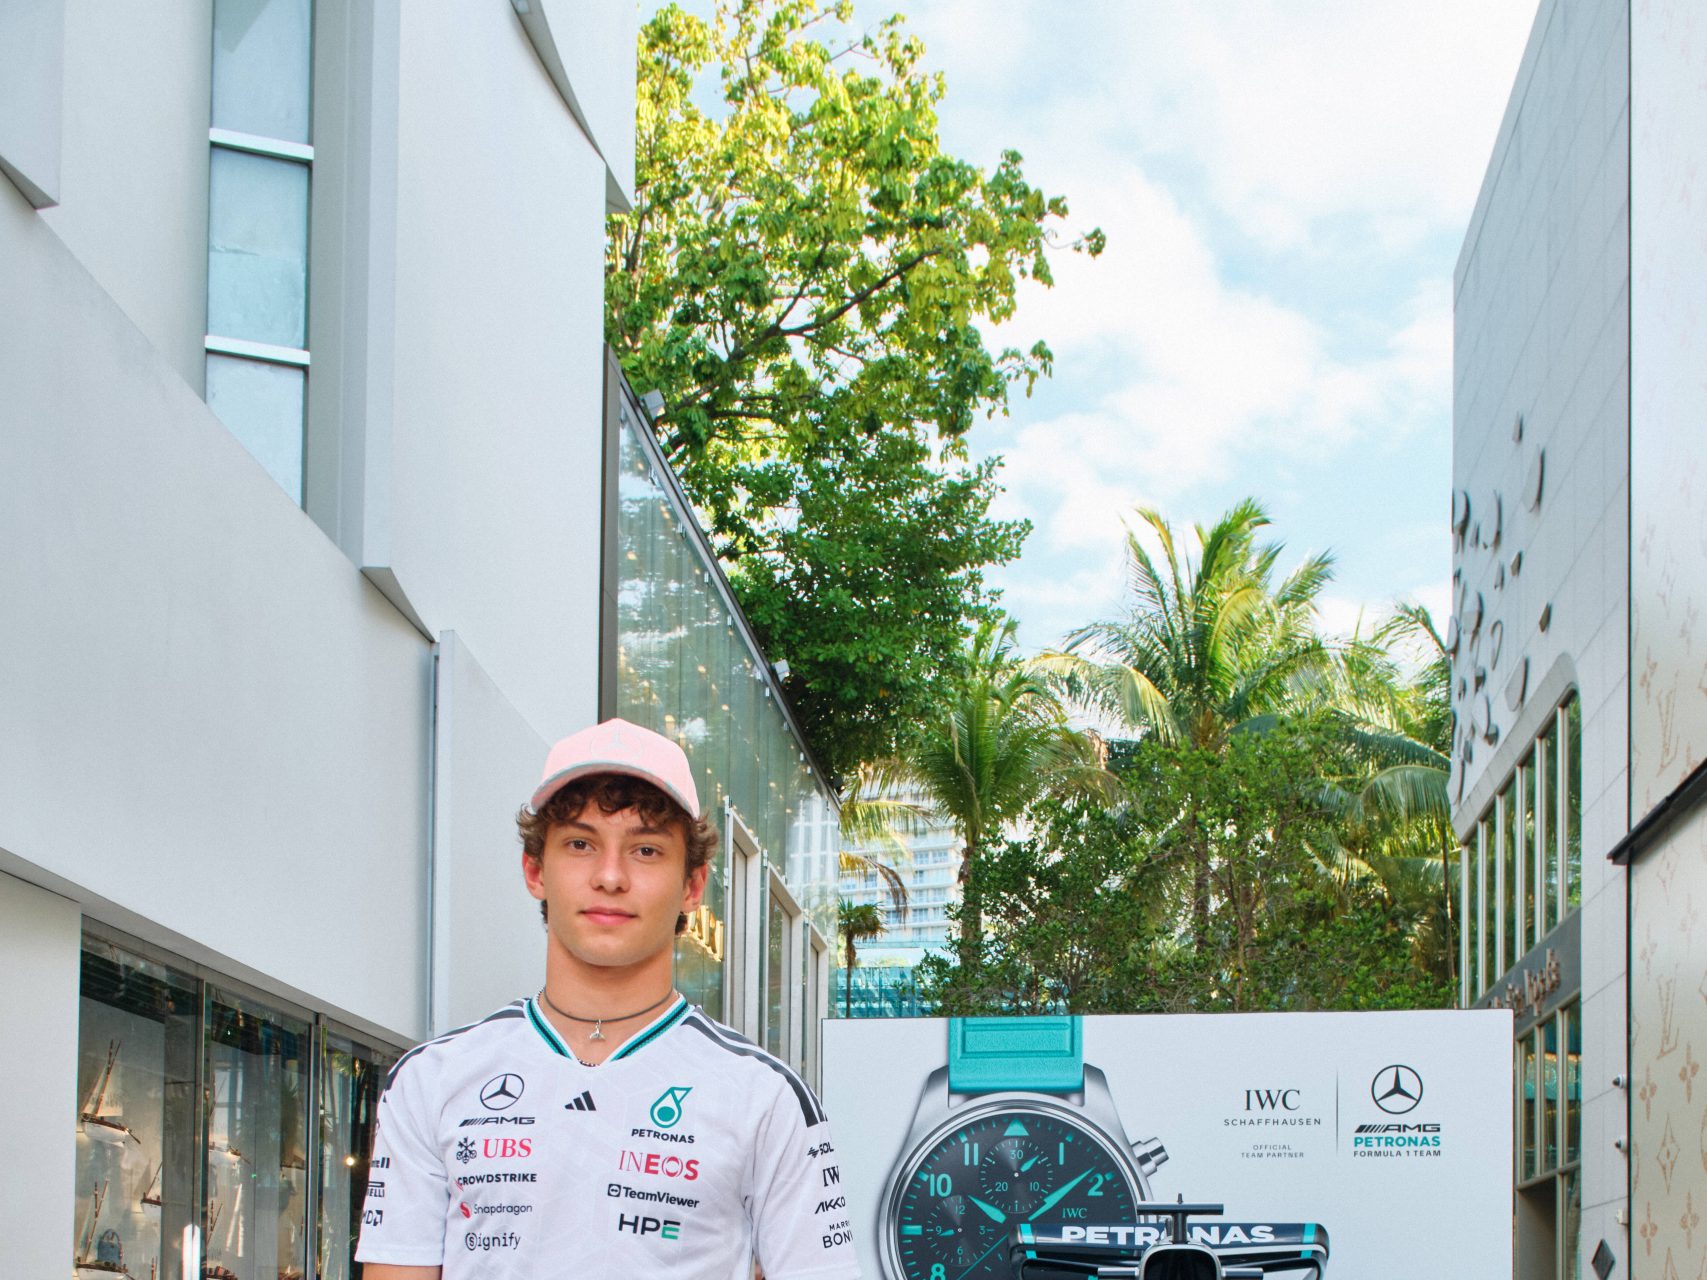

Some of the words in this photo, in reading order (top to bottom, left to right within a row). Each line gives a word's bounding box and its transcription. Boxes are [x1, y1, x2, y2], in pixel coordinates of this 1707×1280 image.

[1244, 1089, 1301, 1111] IWC
[482, 1116, 536, 1126] AMG
[1223, 1118, 1322, 1127] SCHAFFHAUSEN
[1383, 1123, 1441, 1133] AMG
[631, 1128, 695, 1144] PETRONAS
[1353, 1135, 1441, 1148] PETRONAS
[483, 1138, 533, 1159] UBS
[1353, 1150, 1402, 1158] FORMULA
[1414, 1149, 1441, 1157] TEAM
[618, 1150, 700, 1181] INEOS
[457, 1173, 538, 1187] CROWDSTRIKE
[929, 1173, 953, 1197] 10
[1087, 1174, 1104, 1196] 2
[995, 1182, 1009, 1192] 20
[1029, 1182, 1040, 1192] 10
[622, 1186, 700, 1208] TeamViewer
[474, 1203, 533, 1216] Snapdragon
[955, 1205, 966, 1215] 12
[1061, 1207, 1088, 1219] IWC
[618, 1213, 681, 1240] HPE
[957, 1246, 964, 1255] 6
